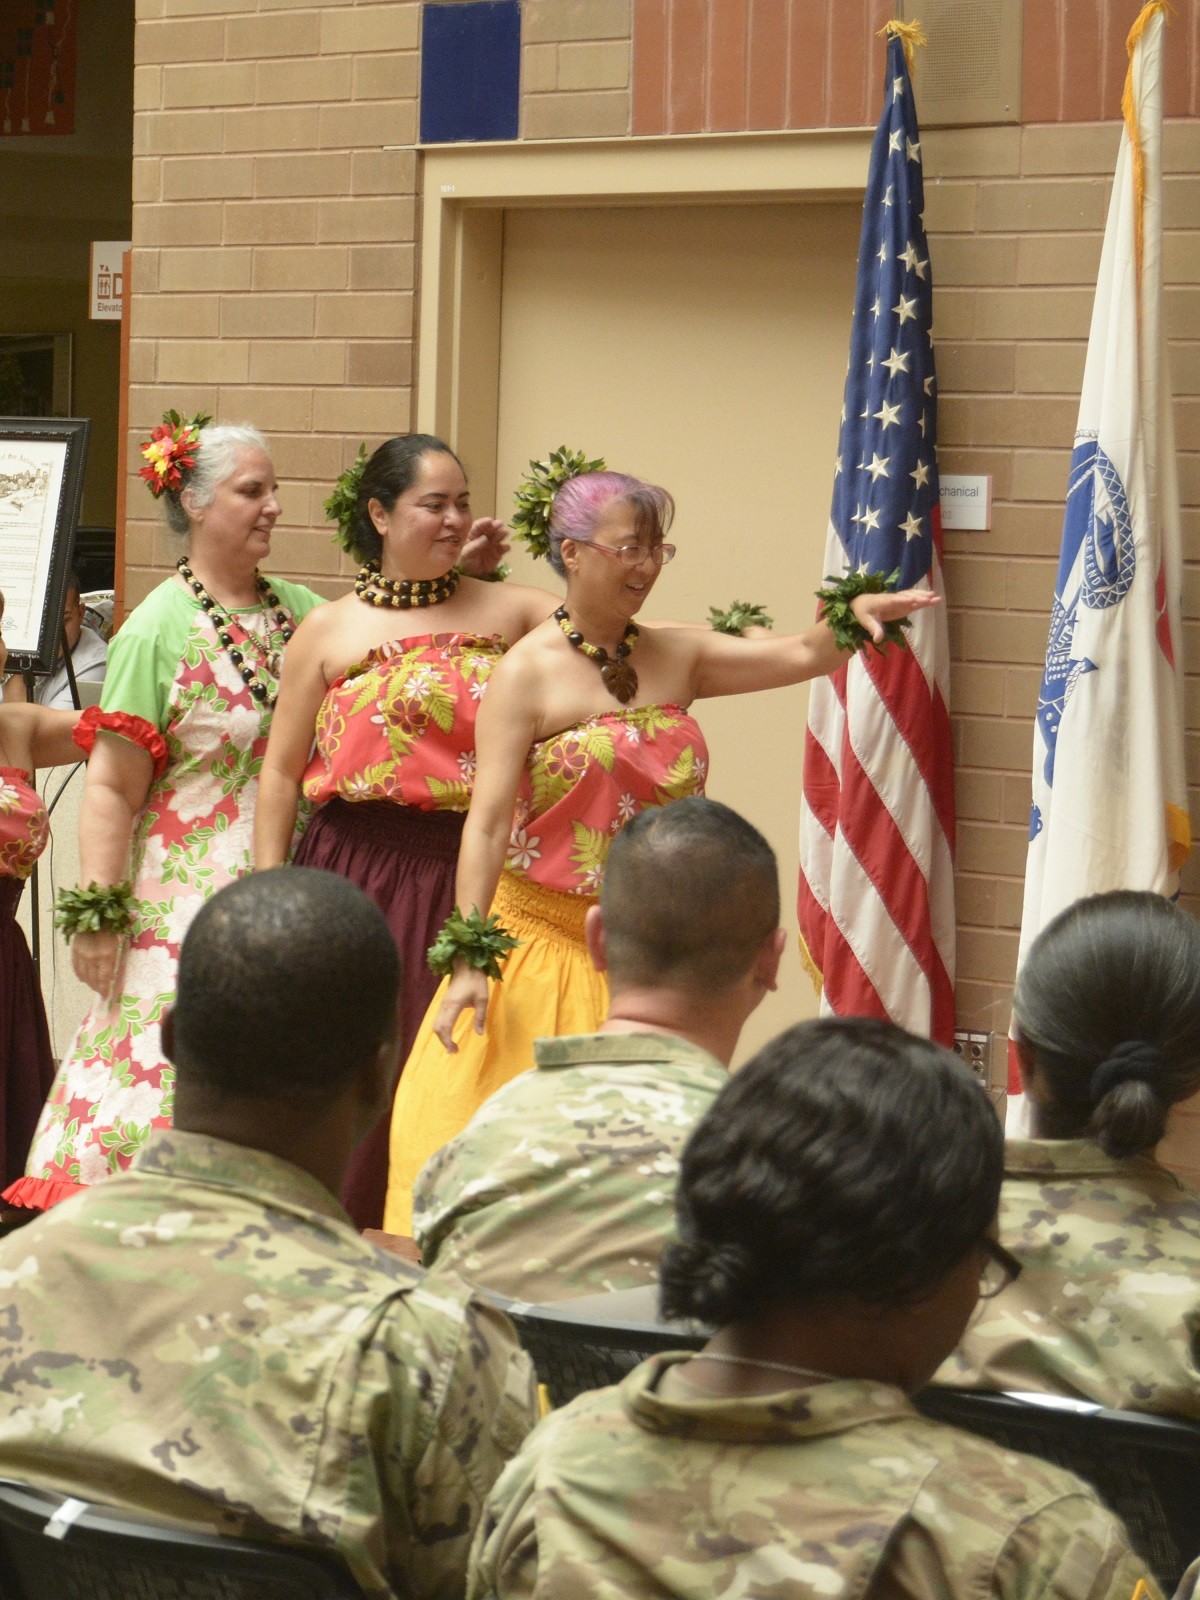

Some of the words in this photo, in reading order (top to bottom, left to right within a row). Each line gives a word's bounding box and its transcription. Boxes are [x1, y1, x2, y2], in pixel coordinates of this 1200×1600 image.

[97, 302, 123, 312] Elevato
[939, 485, 979, 497] chanical
[1086, 535, 1101, 586] DEFEND
